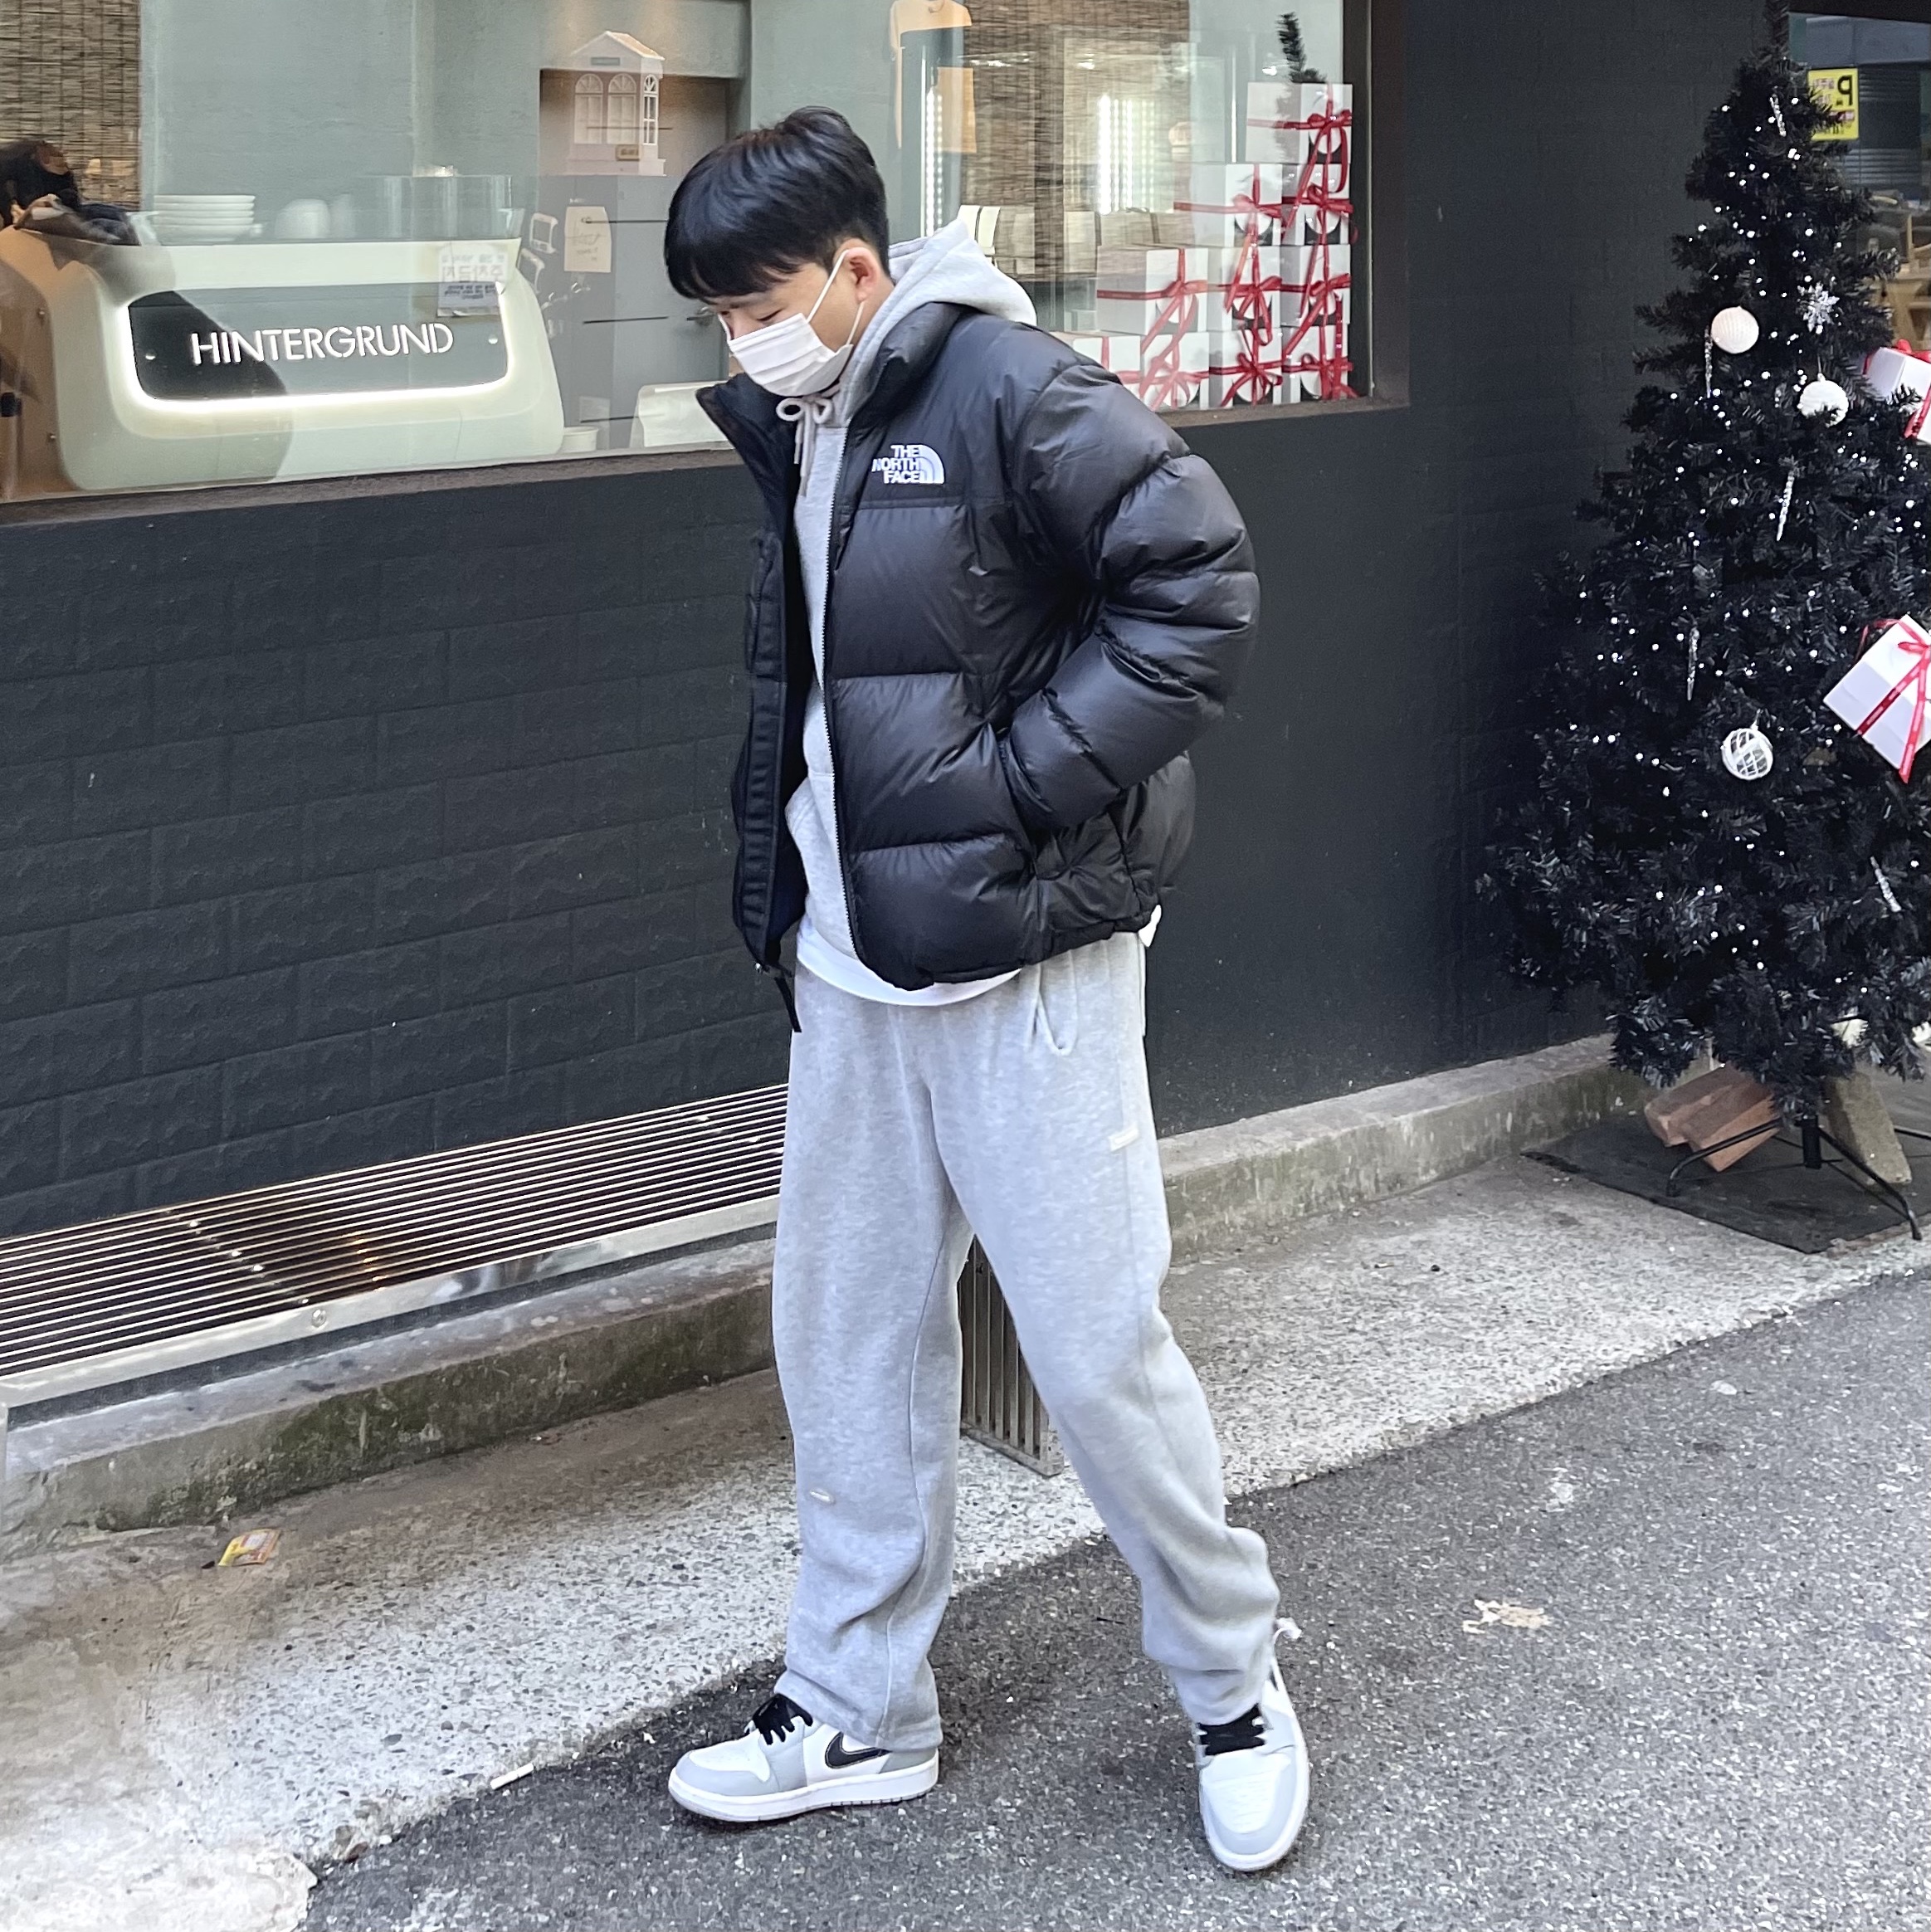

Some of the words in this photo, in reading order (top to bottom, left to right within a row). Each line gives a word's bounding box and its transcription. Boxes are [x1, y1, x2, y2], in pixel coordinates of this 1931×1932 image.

[191, 322, 455, 366] HINTERGRUND
[890, 444, 919, 457] THE
[871, 457, 920, 471] NORTH
[884, 471, 920, 484] FACE
